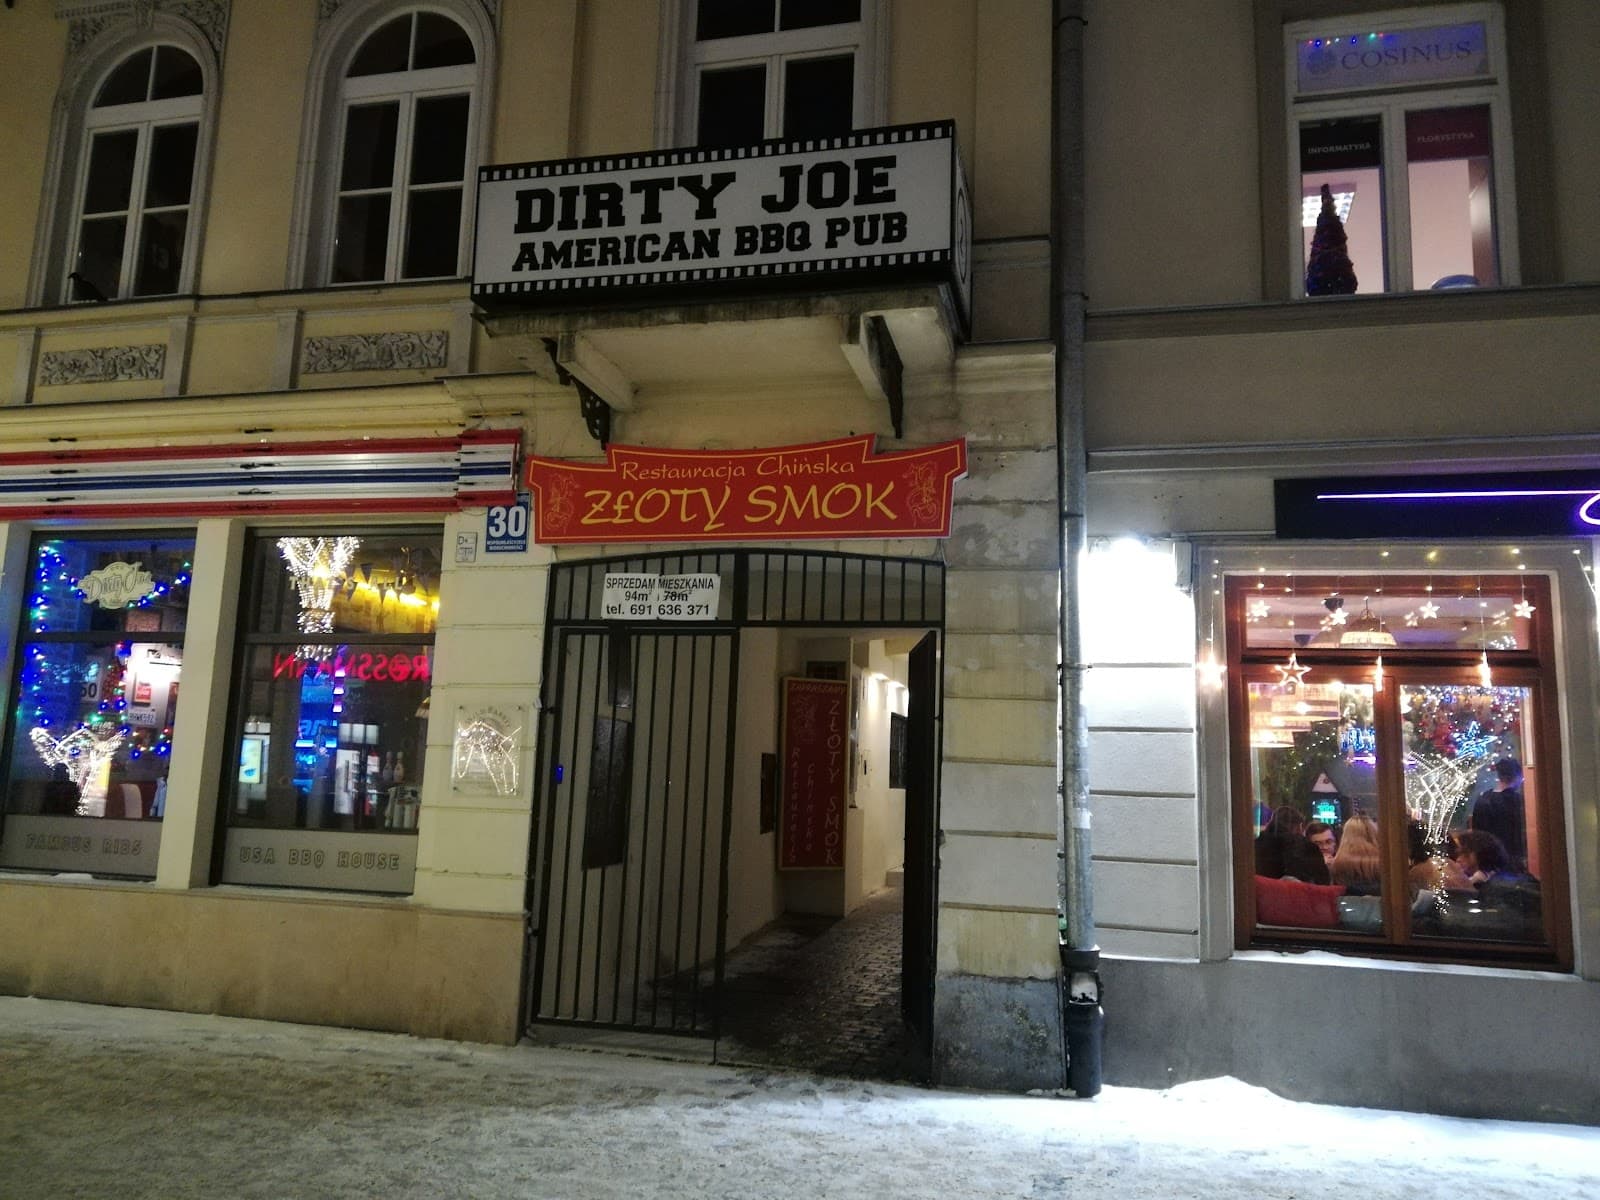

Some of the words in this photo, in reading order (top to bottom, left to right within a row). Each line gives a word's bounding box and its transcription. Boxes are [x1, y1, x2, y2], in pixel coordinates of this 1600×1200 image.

[1341, 41, 1471, 69] COSINUS
[1307, 141, 1371, 155] INFORMATYKA
[1416, 131, 1474, 144] FLORYSTYKA
[513, 172, 736, 234] DIRTY
[761, 155, 897, 215] JOE
[512, 228, 720, 272] AMERICAN
[734, 222, 812, 257] BBQ
[825, 212, 908, 249] PUB
[621, 460, 746, 484] Restauracja
[756, 454, 855, 476] Chińska
[580, 486, 731, 532] ZŁOTY
[744, 481, 897, 526] SMOK
[488, 505, 526, 538] 30
[605, 577, 656, 589] SPRZEDAM
[657, 577, 715, 590] MIESZKANIA
[606, 603, 625, 615] tel.
[630, 604, 653, 616] 691
[657, 604, 682, 616] 636
[687, 603, 710, 615] 371
[824, 796, 840, 864] SMOK
[102, 837, 143, 857] RIBS
[239, 846, 275, 865] USA
[288, 848, 325, 869] BBQ
[337, 850, 400, 871] HOUSE
